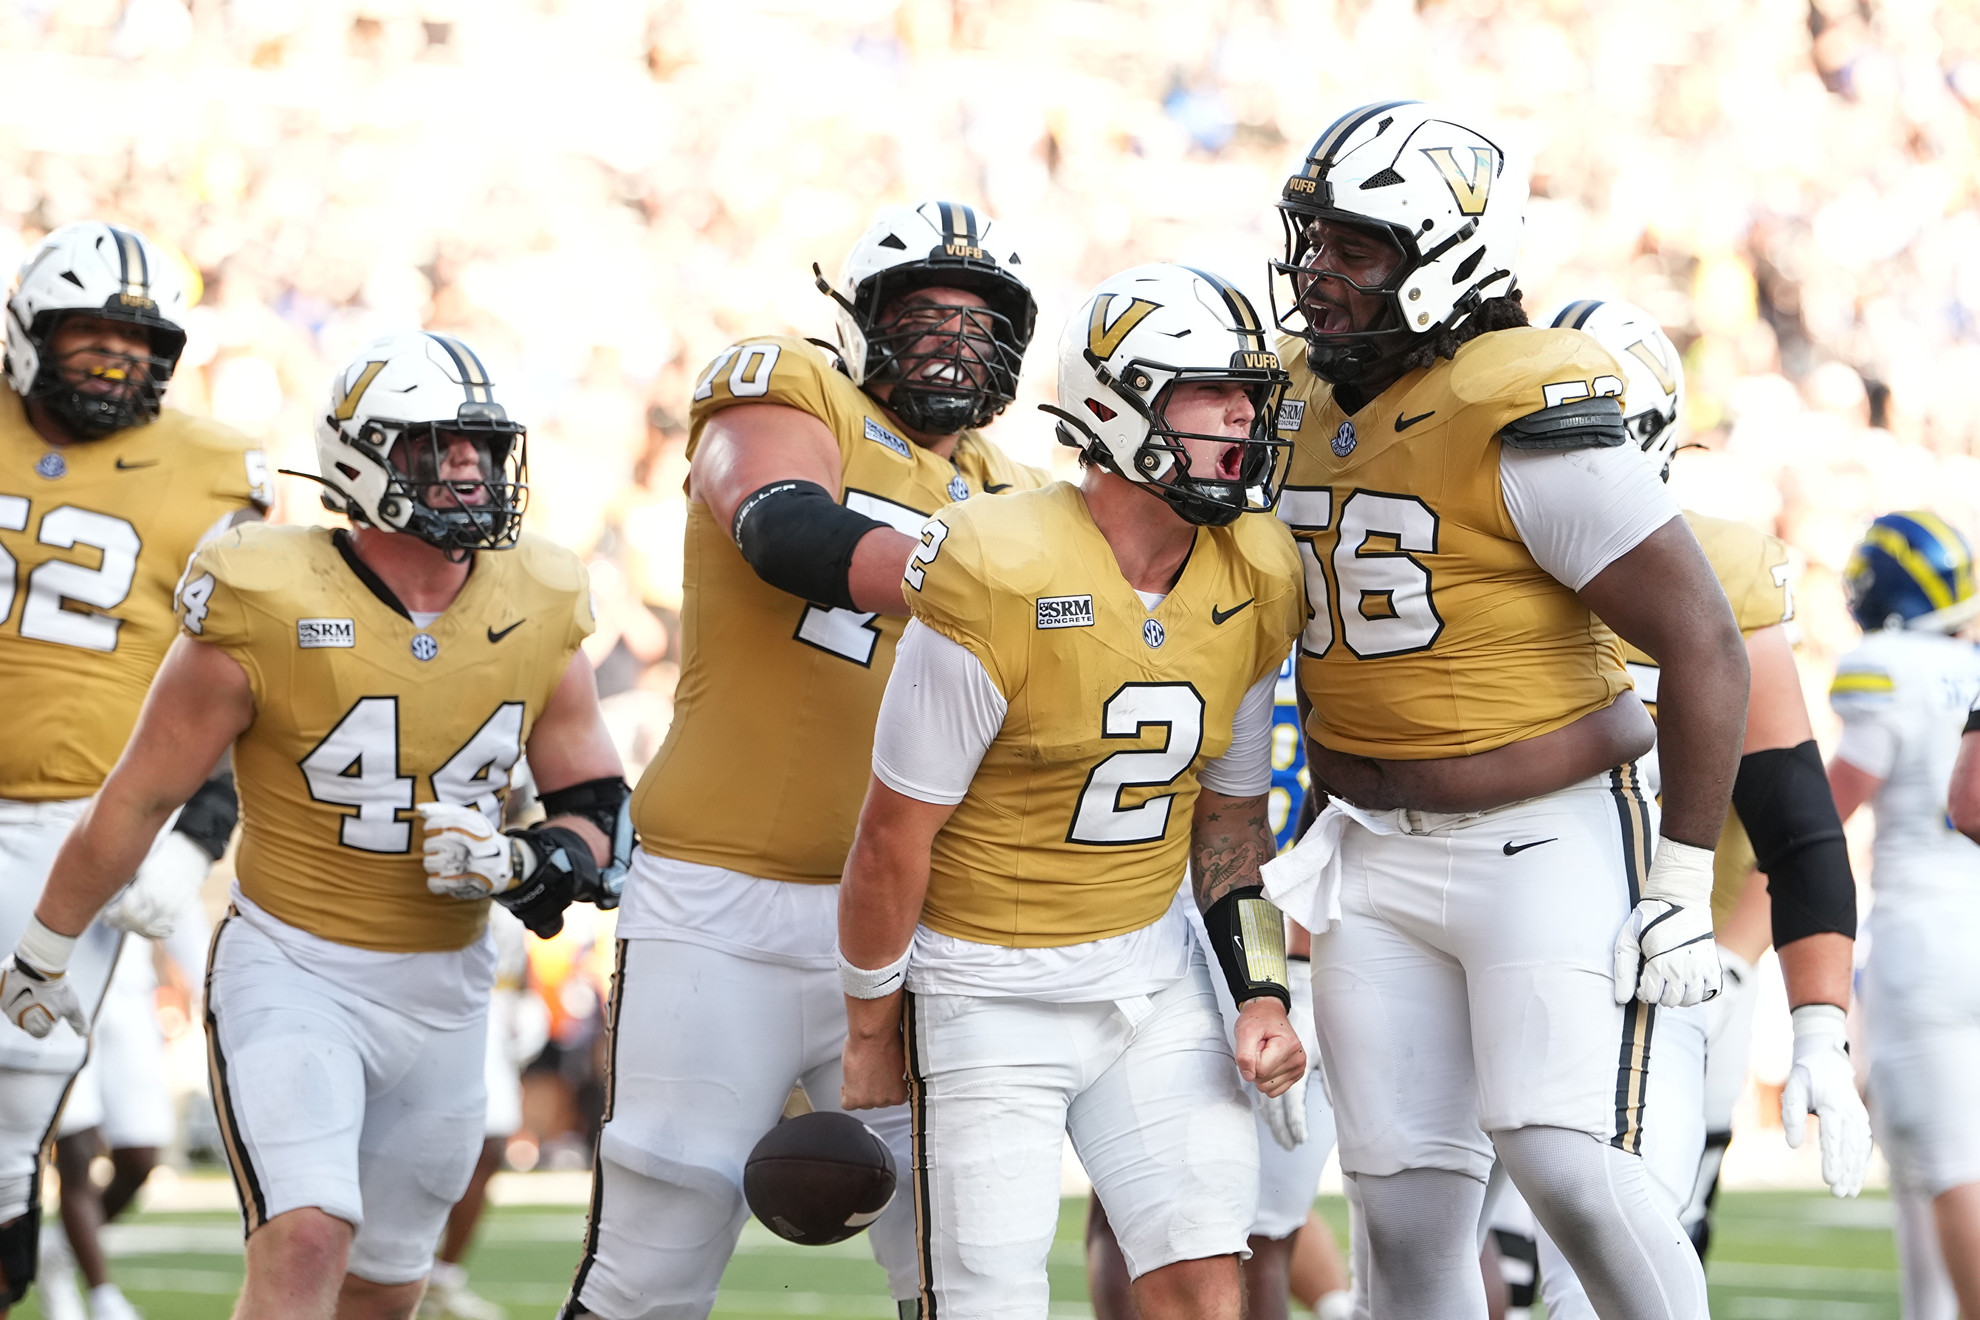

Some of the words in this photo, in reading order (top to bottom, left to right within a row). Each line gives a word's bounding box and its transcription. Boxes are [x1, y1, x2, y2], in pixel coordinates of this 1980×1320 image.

[1290, 178, 1316, 194] VUFB
[1418, 147, 1493, 216] V
[945, 243, 983, 259] VUFB
[1087, 293, 1165, 362] V
[694, 344, 782, 402] 70
[1244, 353, 1278, 369] VUFB
[904, 518, 949, 592] 2
[1276, 485, 1446, 661] 56
[309, 623, 352, 638] SRM
[1038, 615, 1092, 625] CONCRETE
[1048, 600, 1092, 618] SRM
[1144, 619, 1165, 648] SEC
[297, 695, 526, 855] 44
[1064, 681, 1207, 847] 2
